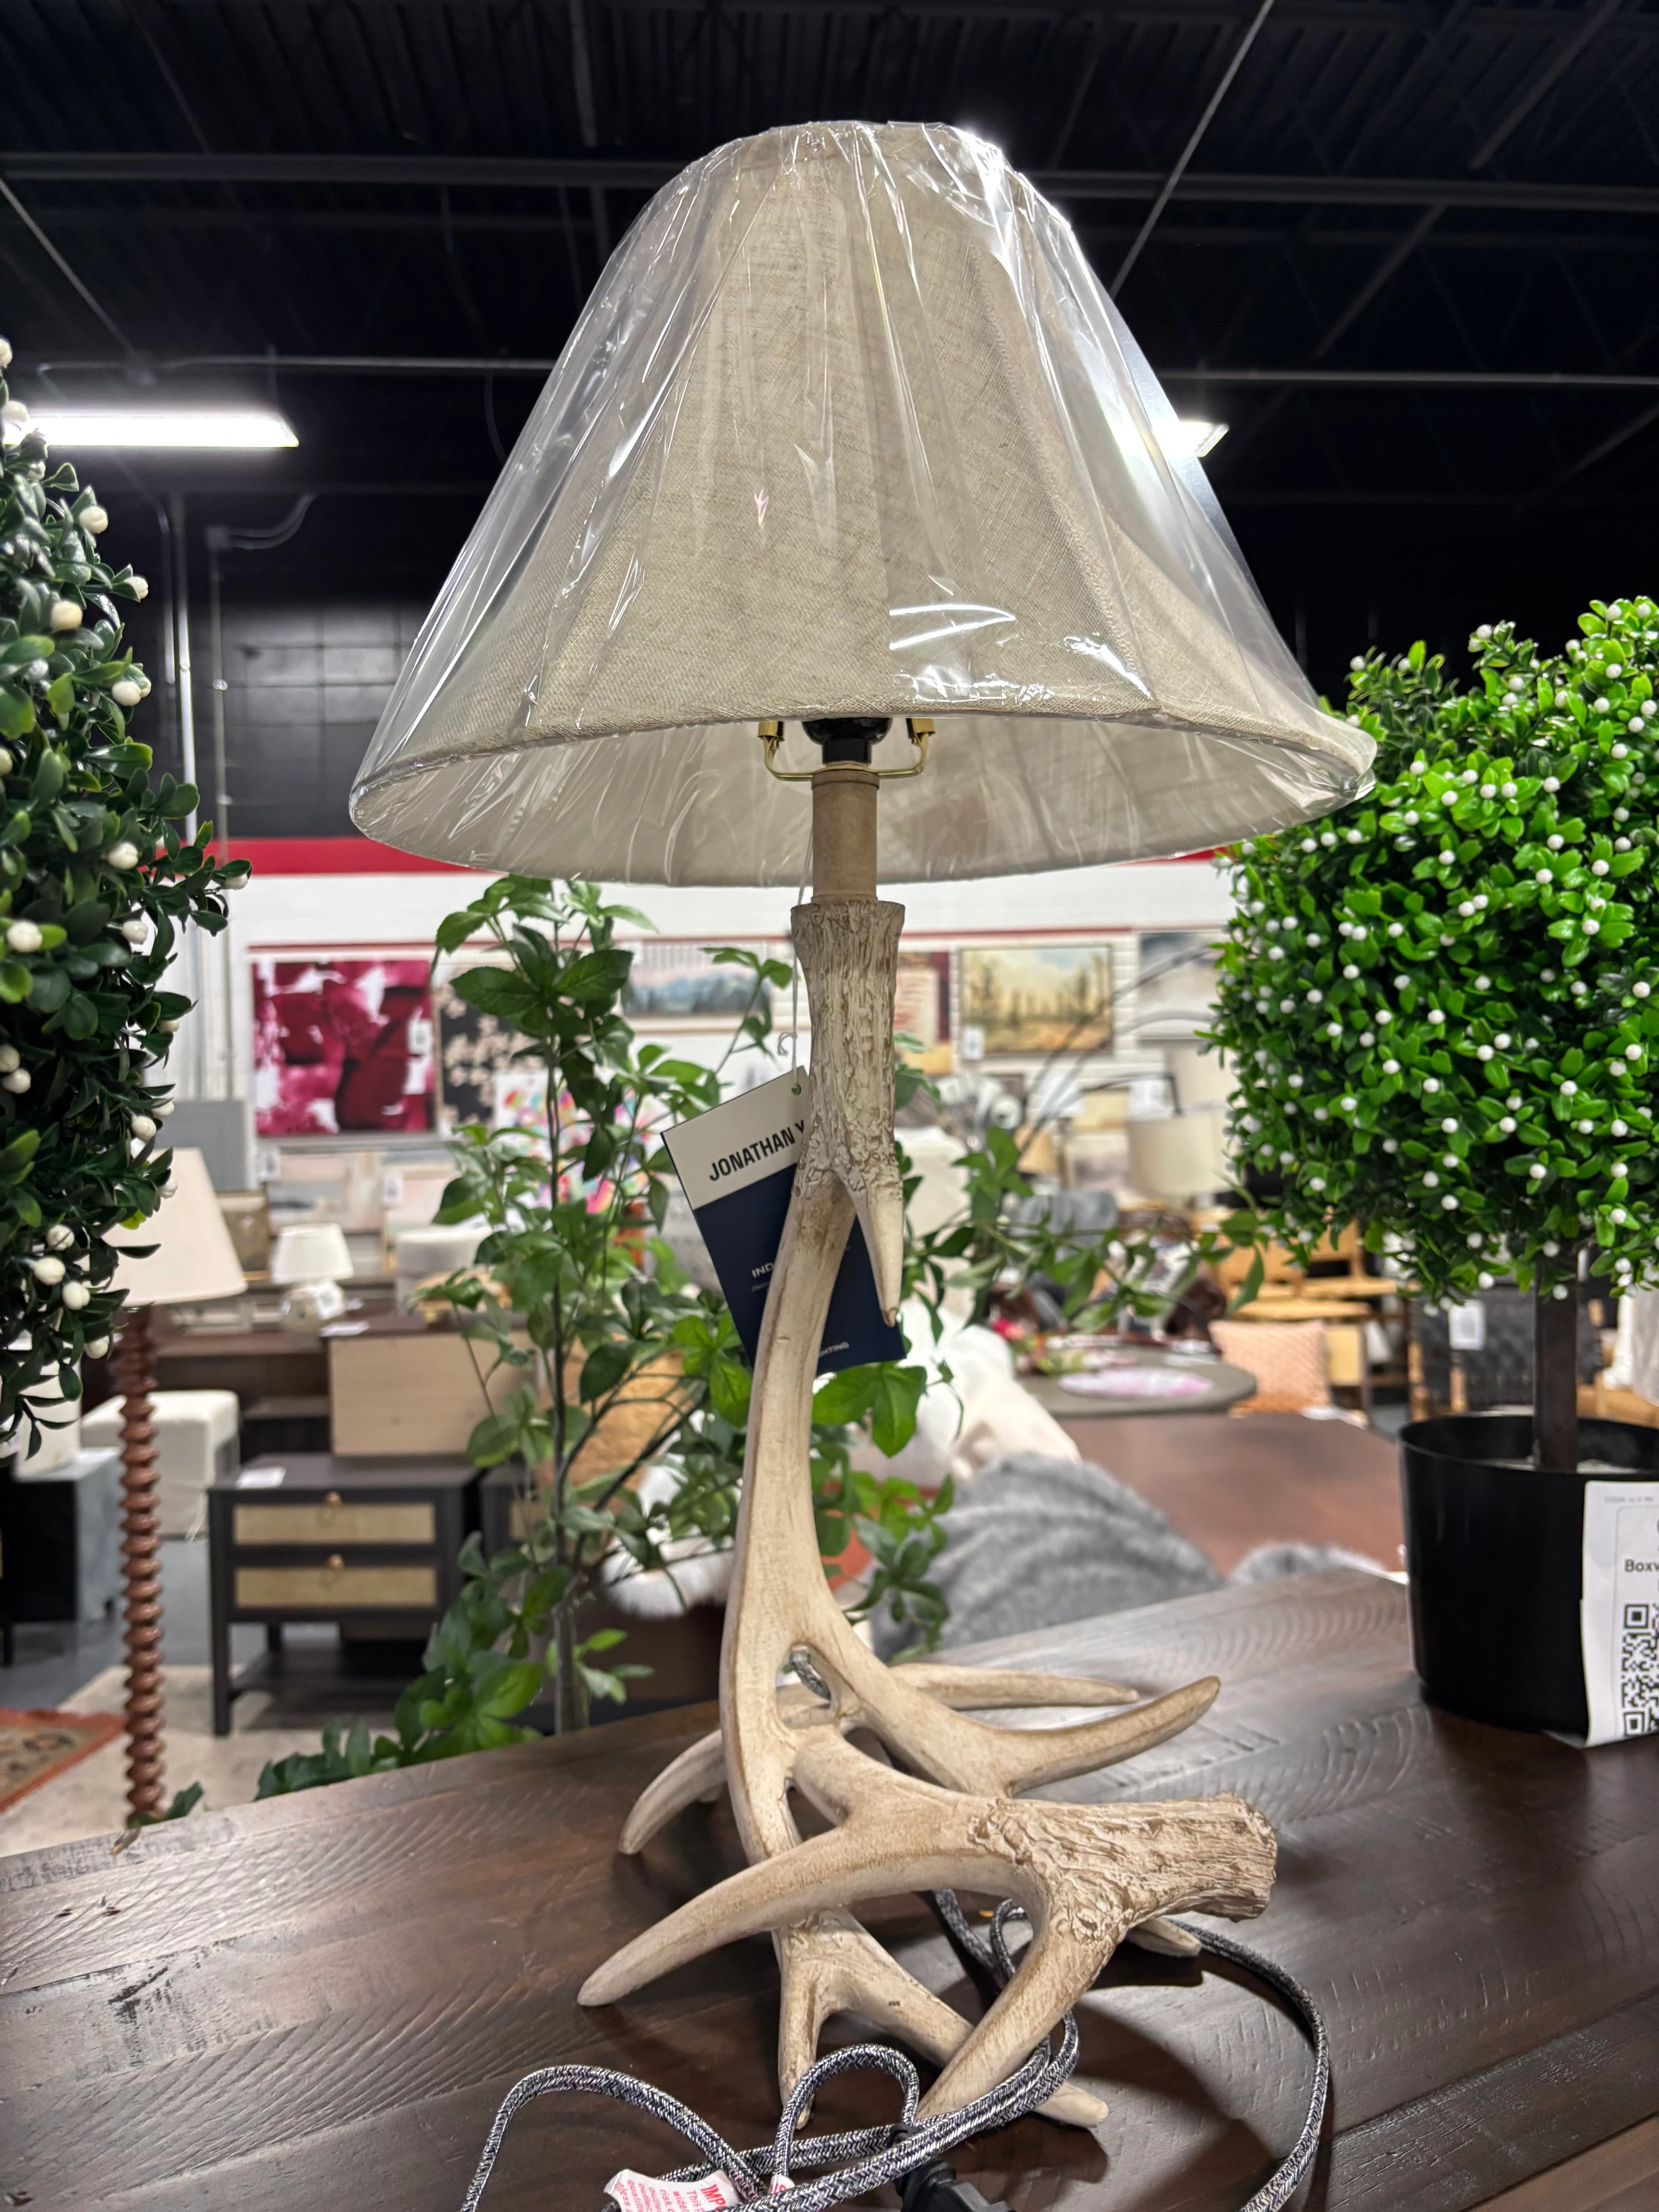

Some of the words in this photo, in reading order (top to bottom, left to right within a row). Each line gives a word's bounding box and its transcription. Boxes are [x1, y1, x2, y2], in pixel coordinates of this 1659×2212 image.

[709, 1127, 796, 1181] JONATHAN
[660, 2189, 673, 2206] risk
[687, 2190, 702, 2207] This
